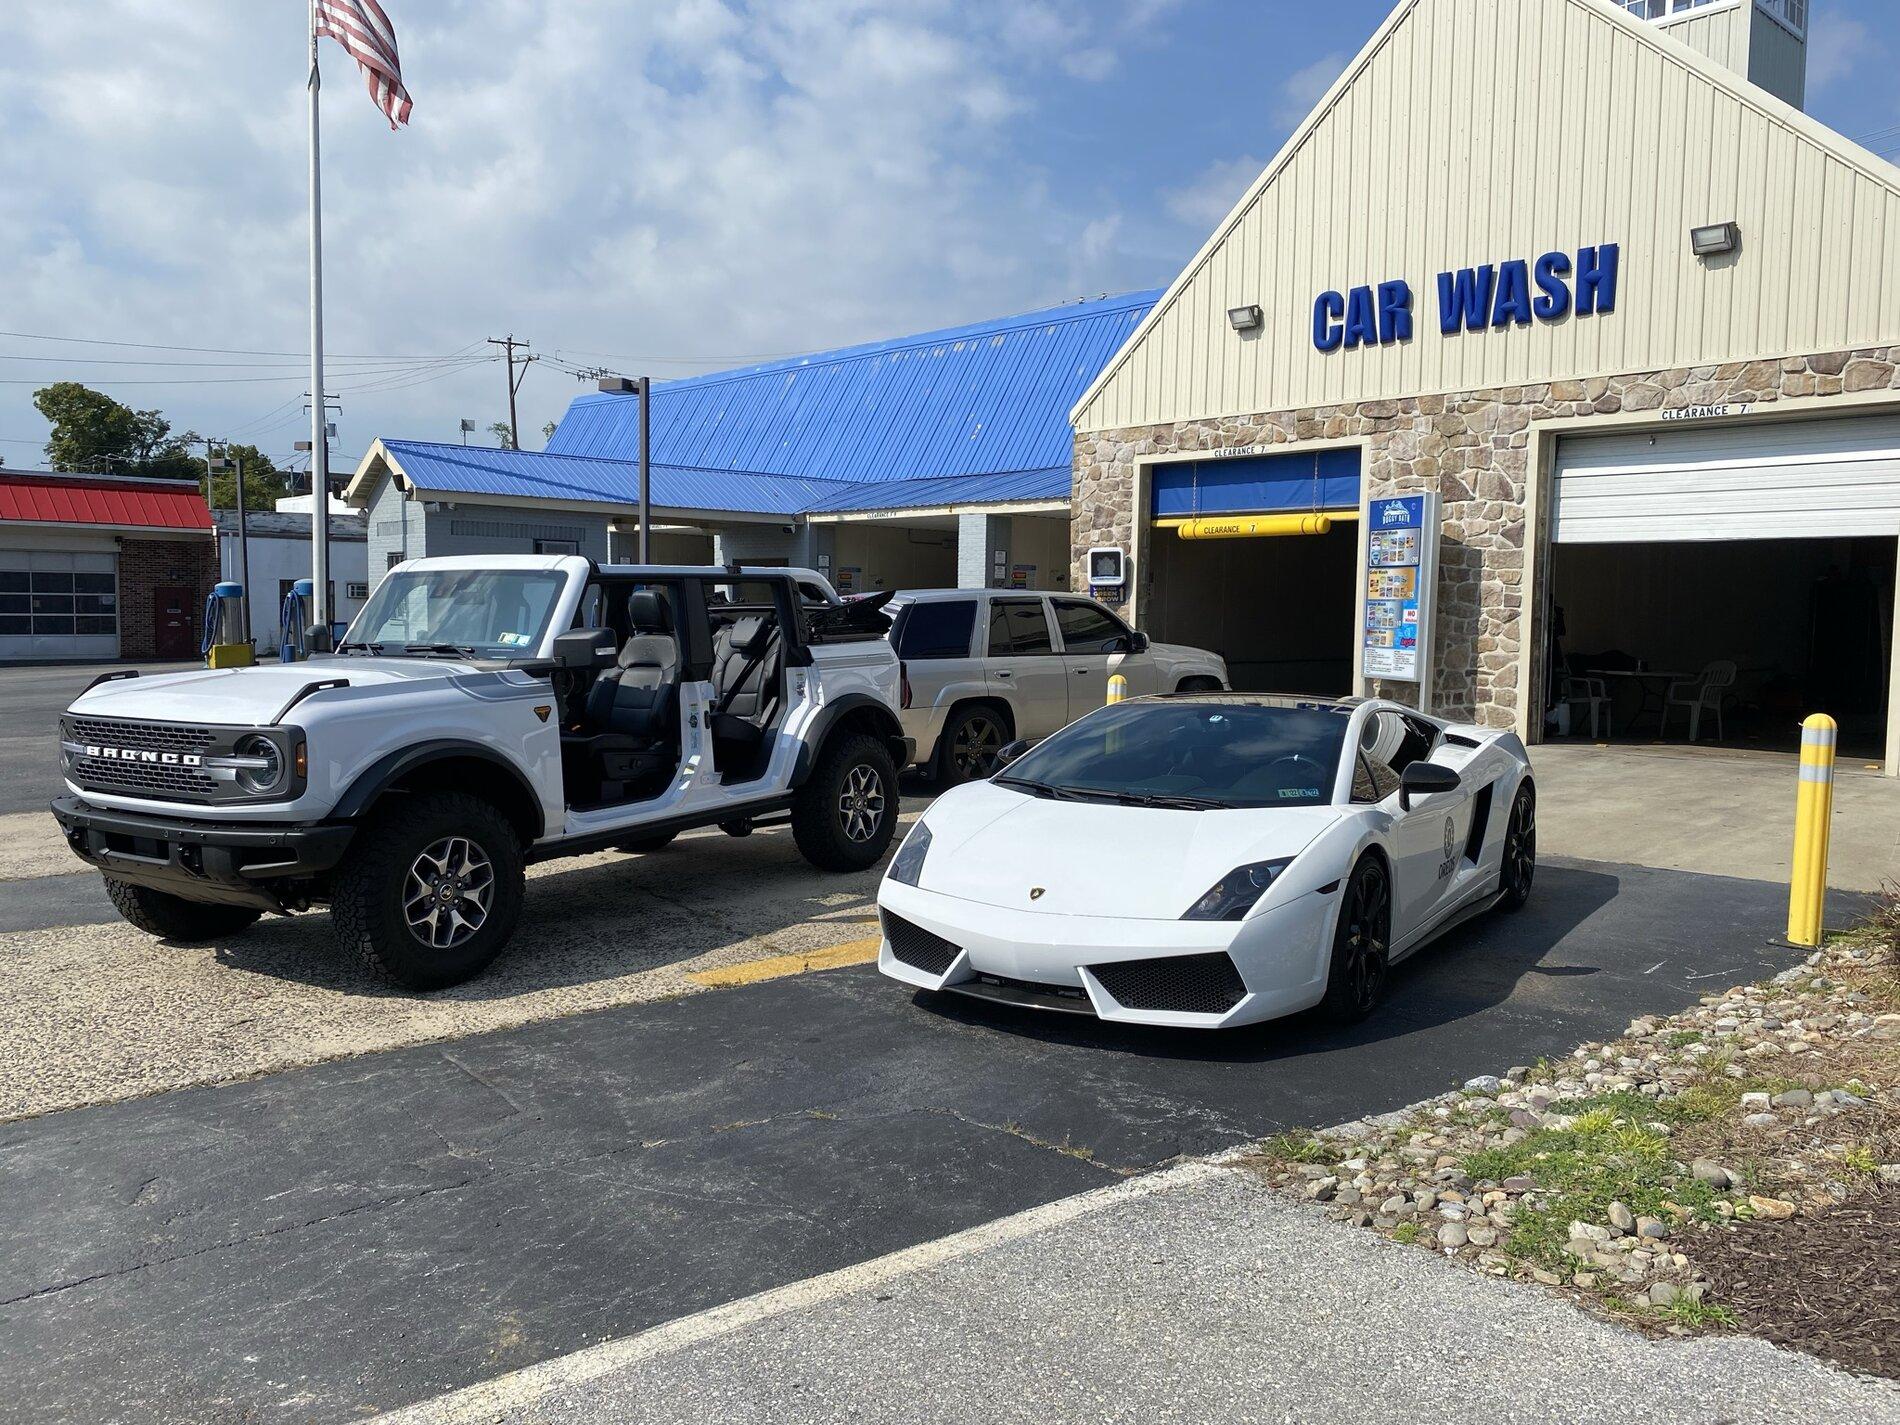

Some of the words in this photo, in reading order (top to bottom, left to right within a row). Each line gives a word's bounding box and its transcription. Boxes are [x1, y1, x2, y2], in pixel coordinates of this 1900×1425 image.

[1312, 279, 1413, 353] CAR
[1437, 243, 1620, 336] WASH
[1662, 405, 1729, 420] CLEARANCE
[1214, 446, 1255, 458] CLEARANCE
[1203, 525, 1240, 535] CLEARANCE
[86, 745, 202, 766] BRONCO
